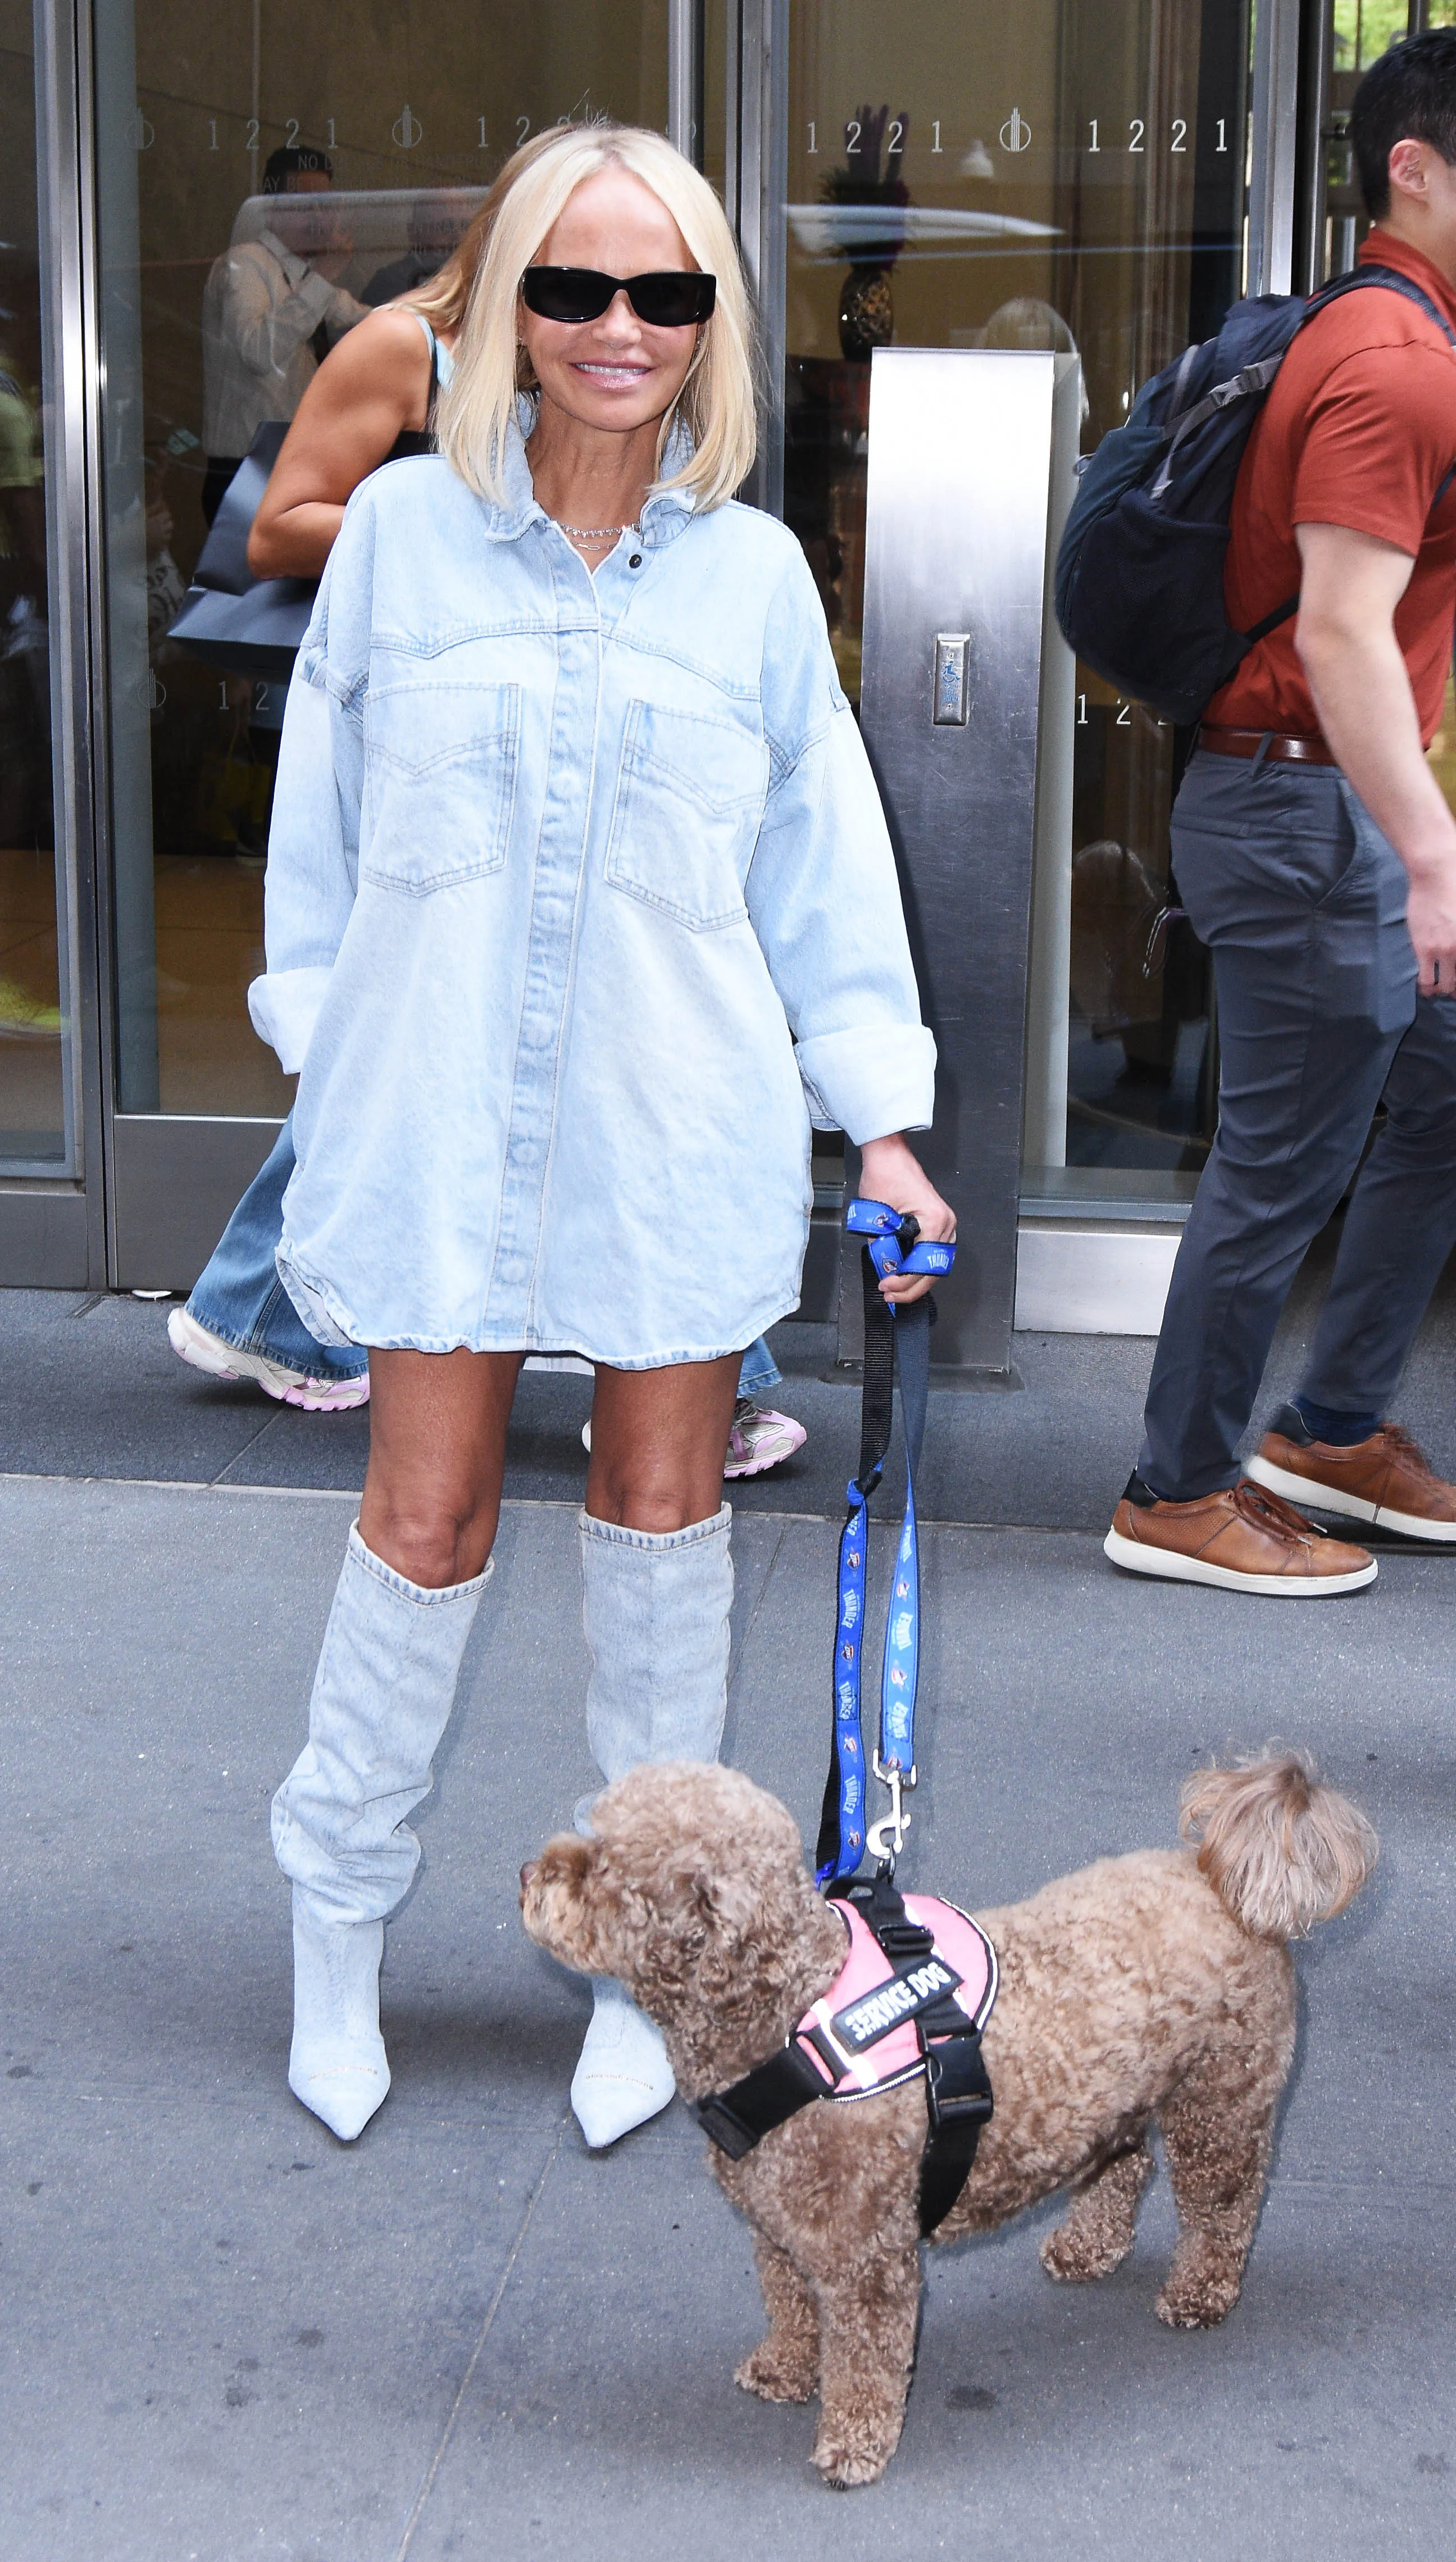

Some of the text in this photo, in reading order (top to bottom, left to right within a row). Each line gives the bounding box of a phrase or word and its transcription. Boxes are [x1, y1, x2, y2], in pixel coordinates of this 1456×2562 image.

[807, 120, 944, 153] 1221
[1089, 119, 1229, 153] 1221
[298, 155, 319, 170] NO
[263, 176, 280, 192] AY
[219, 680, 270, 711] 12
[842, 1588, 857, 1629] THUNDER
[843, 1774, 858, 1815] THUNDER
[845, 1961, 952, 2041] SERVICE DOG
